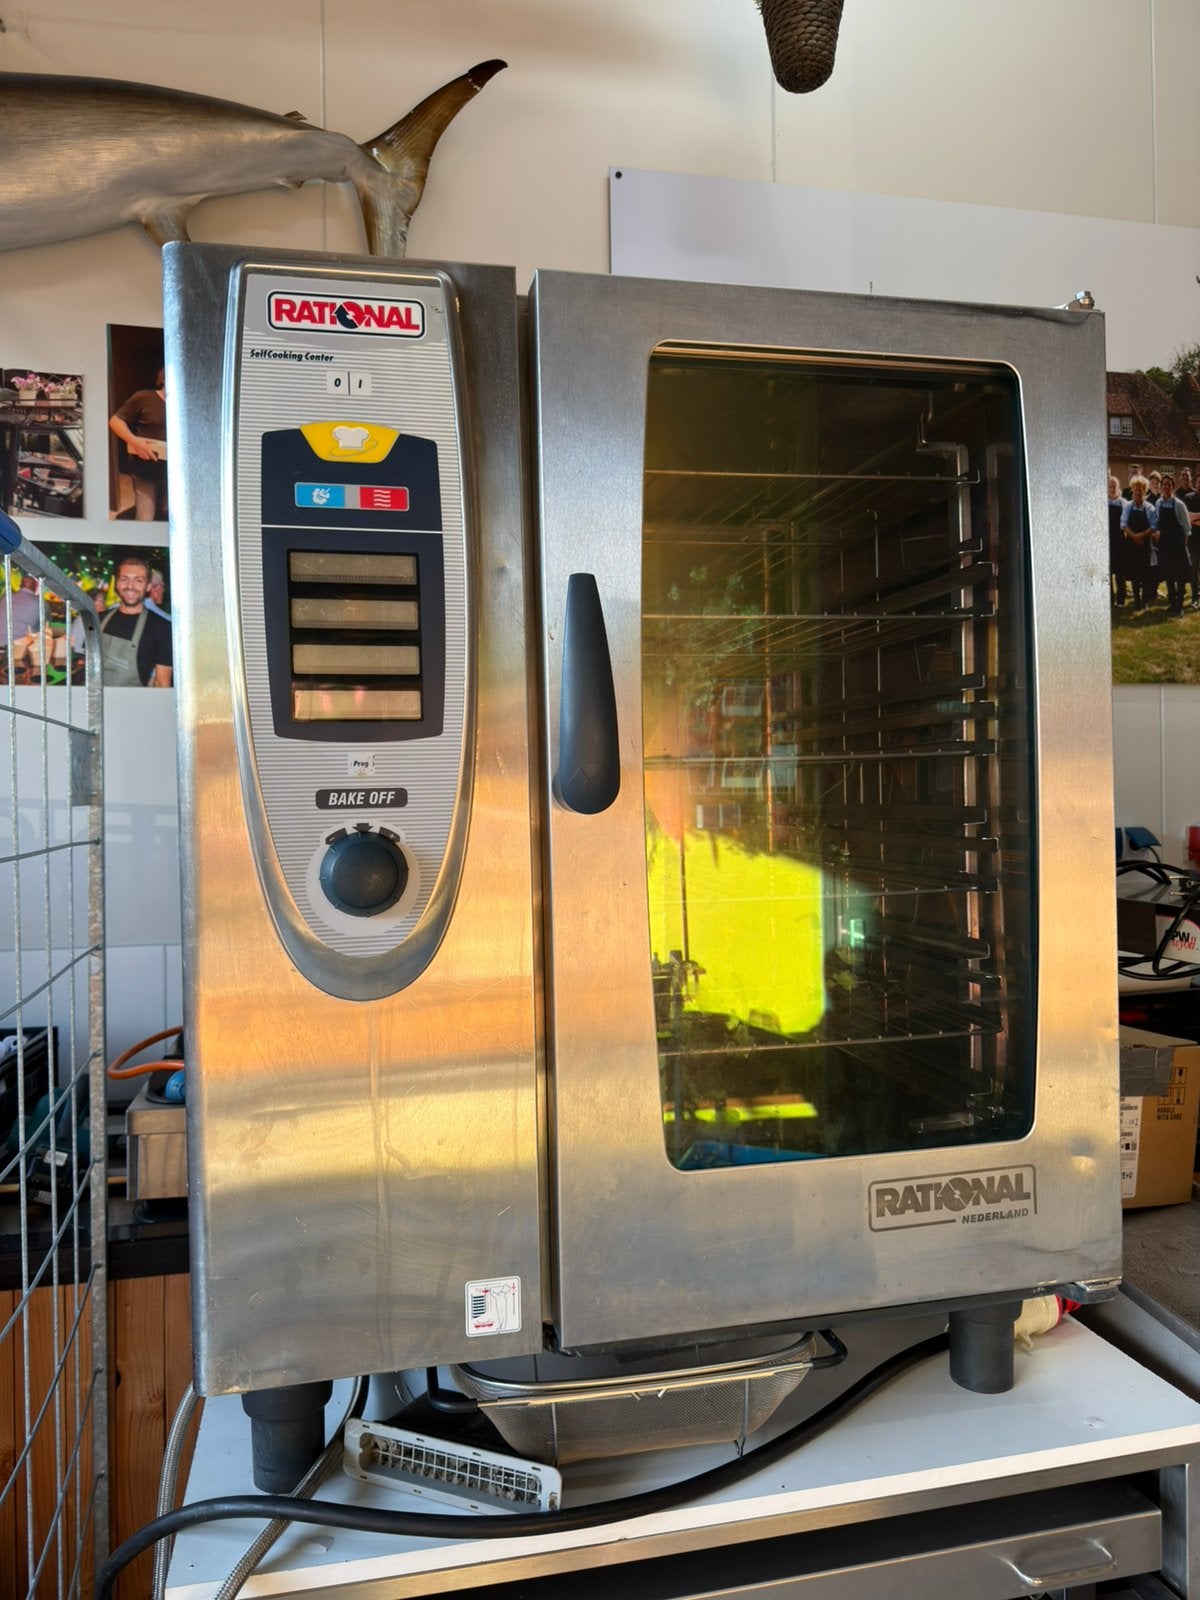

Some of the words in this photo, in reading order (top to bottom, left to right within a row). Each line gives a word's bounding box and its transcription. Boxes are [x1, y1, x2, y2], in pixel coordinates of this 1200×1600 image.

[274, 298, 420, 331] RATIONAL
[250, 349, 302, 362] SelfCooking
[305, 352, 334, 362] Center
[353, 760, 369, 768] Prog
[328, 792, 366, 806] BAKE
[369, 791, 395, 804] OFF
[876, 1173, 1031, 1217] RATIONAL
[962, 1208, 1029, 1224] NEDERLAND
